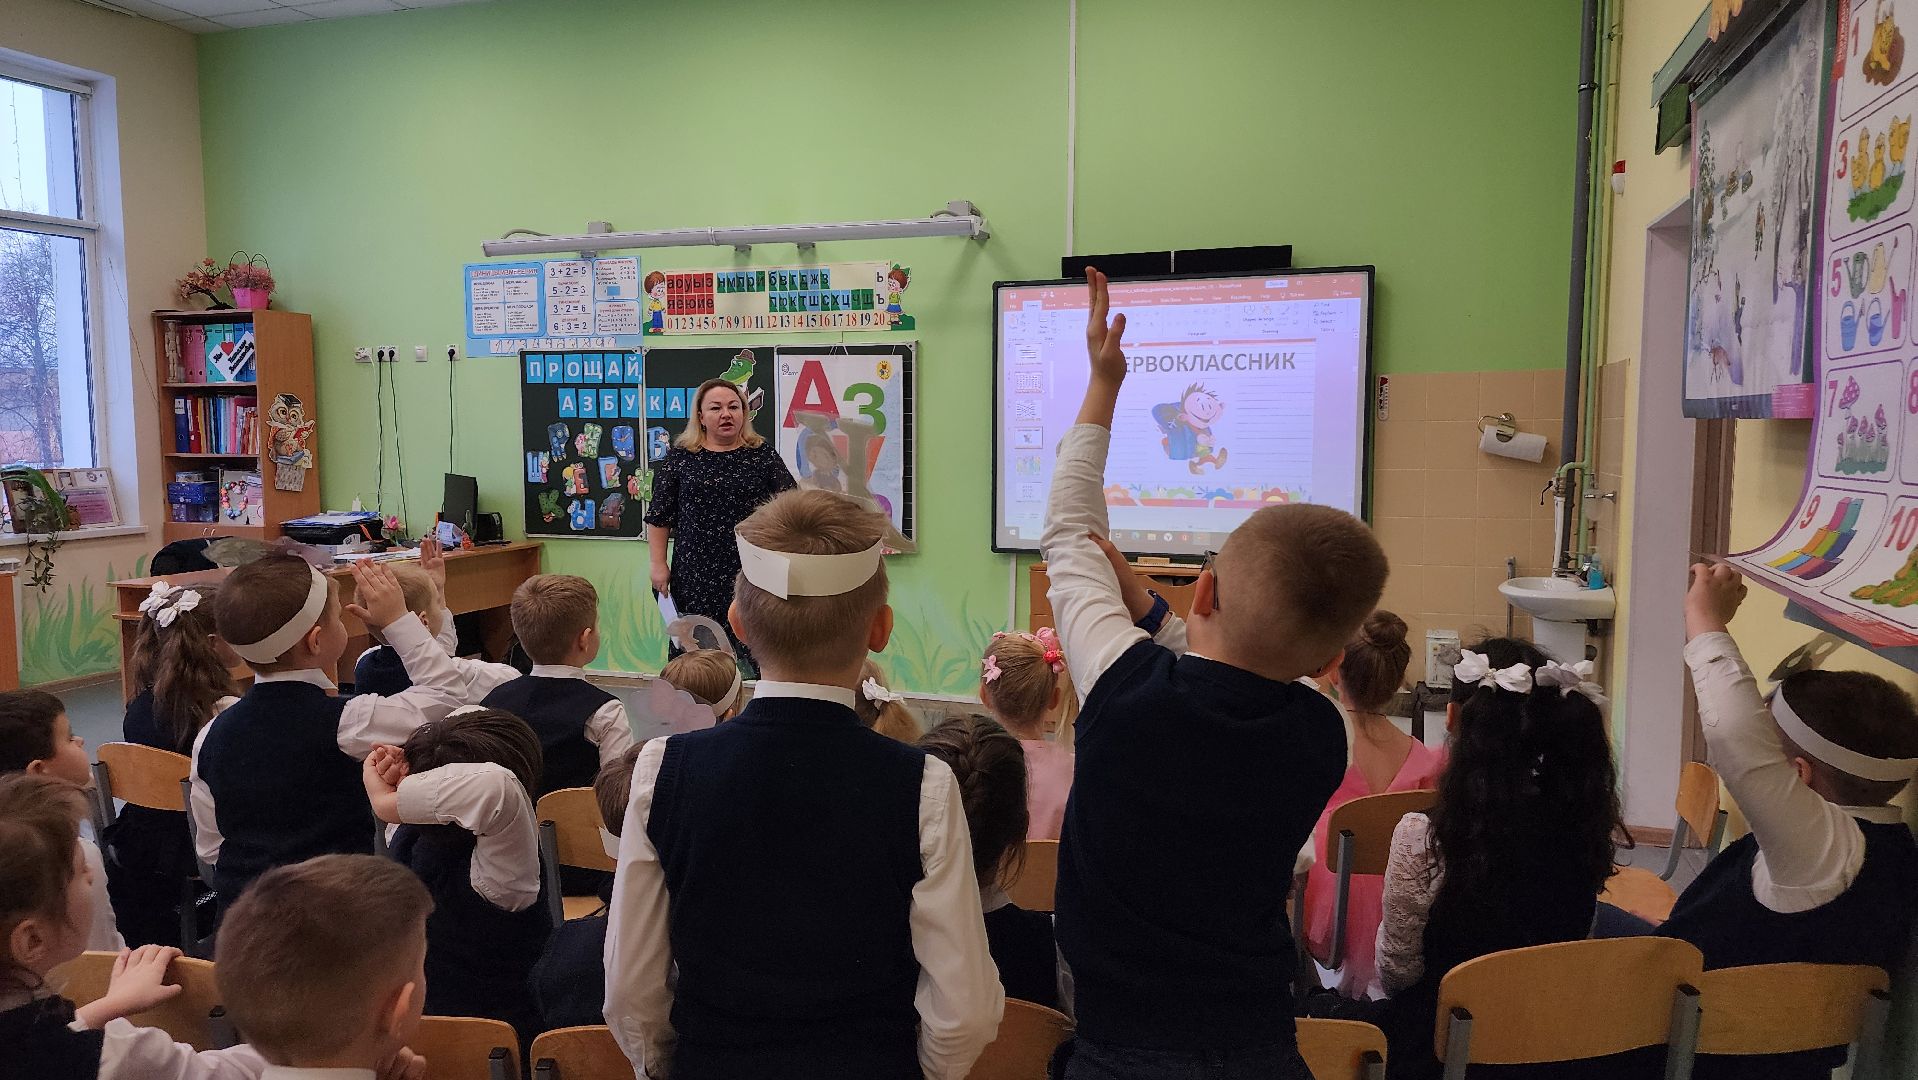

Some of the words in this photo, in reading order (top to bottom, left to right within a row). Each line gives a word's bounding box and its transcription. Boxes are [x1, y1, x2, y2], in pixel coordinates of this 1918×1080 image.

[1852, 16, 1860, 57] 1
[1836, 139, 1848, 180] 3
[550, 267, 556, 277] 3
[565, 267, 571, 276] 2
[581, 266, 587, 275] 5
[1830, 259, 1842, 298] 5
[552, 286, 558, 295] 5
[565, 285, 571, 294] 2
[580, 285, 586, 294] 3
[553, 304, 559, 314] 3
[565, 304, 571, 313] 2
[581, 304, 586, 313] 6
[553, 322, 559, 331] 6
[566, 322, 572, 331] 3
[582, 321, 587, 330] 2
[667, 317, 673, 329] 0
[675, 317, 679, 330] 1
[681, 317, 687, 330] 2
[688, 317, 694, 330] 3
[696, 317, 701, 330] 4
[703, 316, 710, 330] 5
[711, 316, 717, 330] 6
[719, 316, 724, 329] 7
[726, 315, 732, 329] 8
[734, 315, 740, 329] 9
[742, 315, 752, 329] 10
[755, 315, 764, 329] 11
[767, 315, 777, 328] 12
[780, 315, 790, 328] 13
[793, 314, 803, 328] 14
[806, 314, 817, 328] 15
[820, 313, 830, 327] 16
[833, 313, 843, 327] 17
[846, 313, 857, 326] 18
[860, 312, 871, 326] 19
[874, 312, 885, 325] 20
[1125, 352, 1296, 373] ЕРВОКЛАССНИК
[561, 394, 682, 412] АЗБУКА
[1828, 380, 1838, 418] 7
[1799, 494, 1821, 530] 9
[1884, 505, 1918, 551] 10
